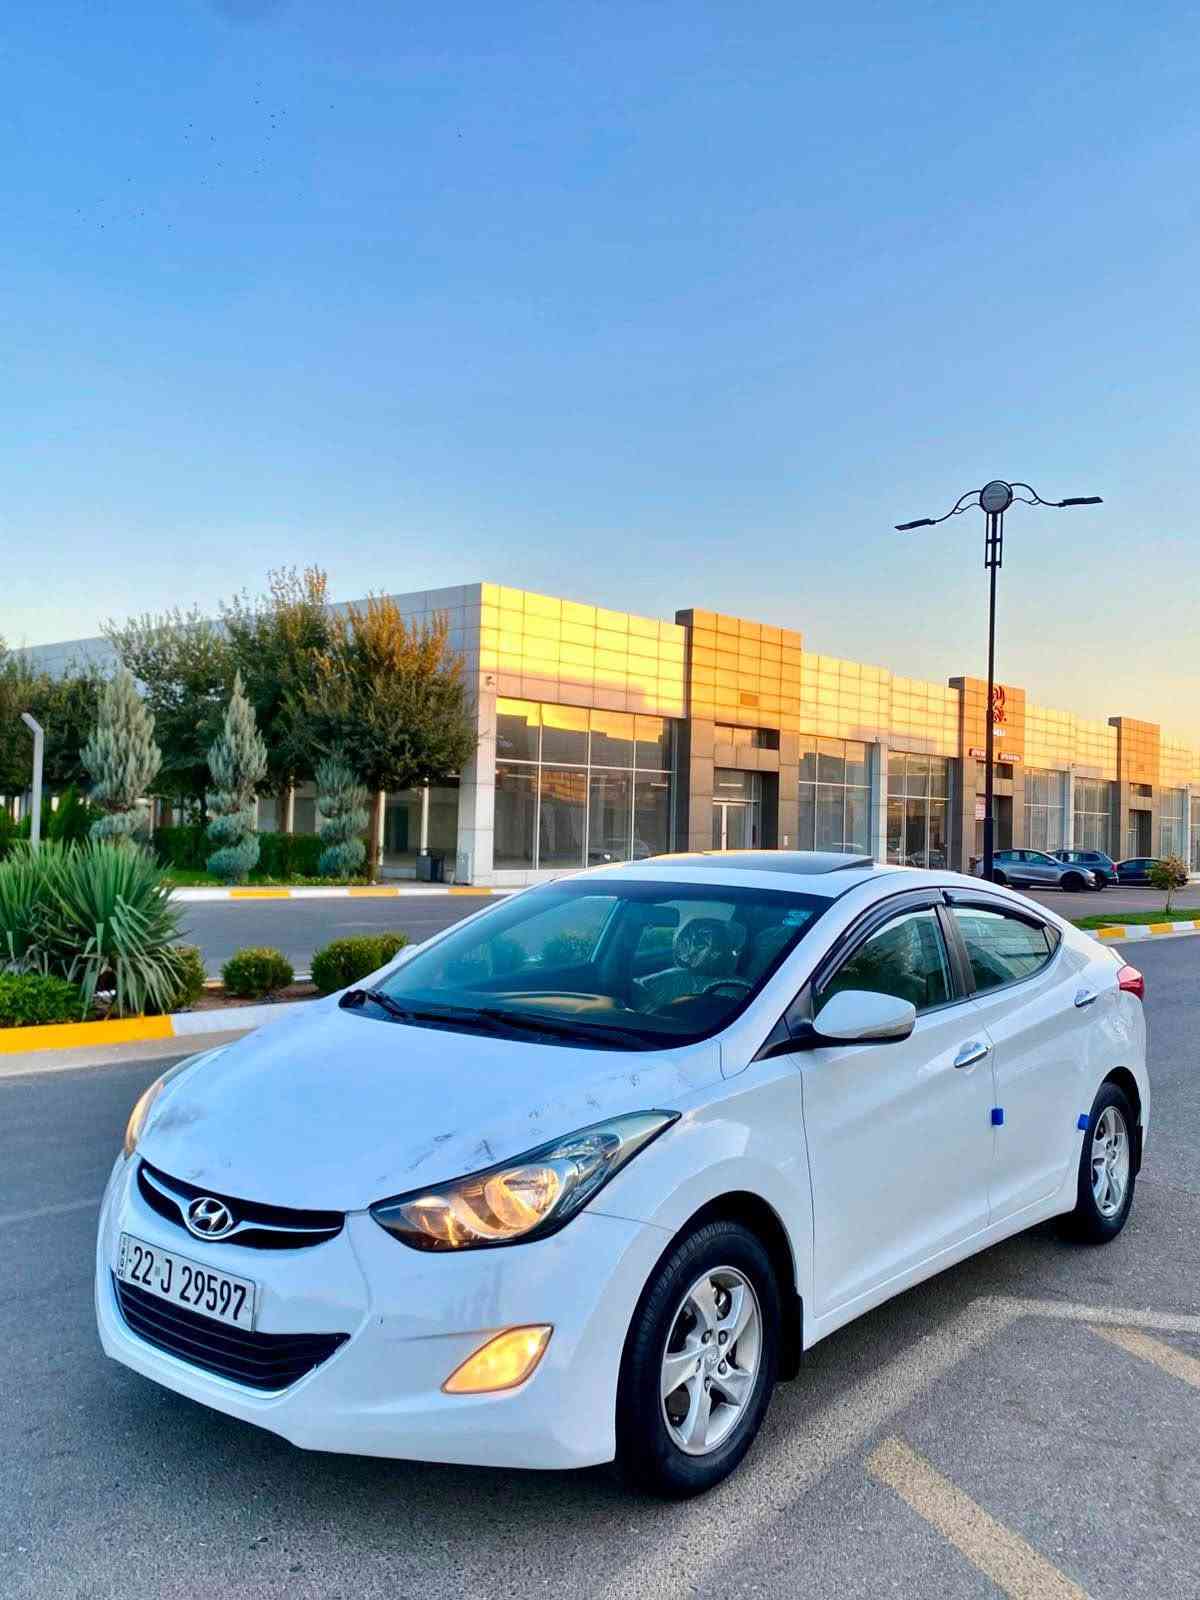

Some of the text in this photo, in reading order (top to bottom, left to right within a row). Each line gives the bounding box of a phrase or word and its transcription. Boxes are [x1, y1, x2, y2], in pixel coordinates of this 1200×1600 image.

[131, 1246, 154, 1286] 22
[160, 1258, 173, 1293] J
[179, 1265, 247, 1321] 29597
